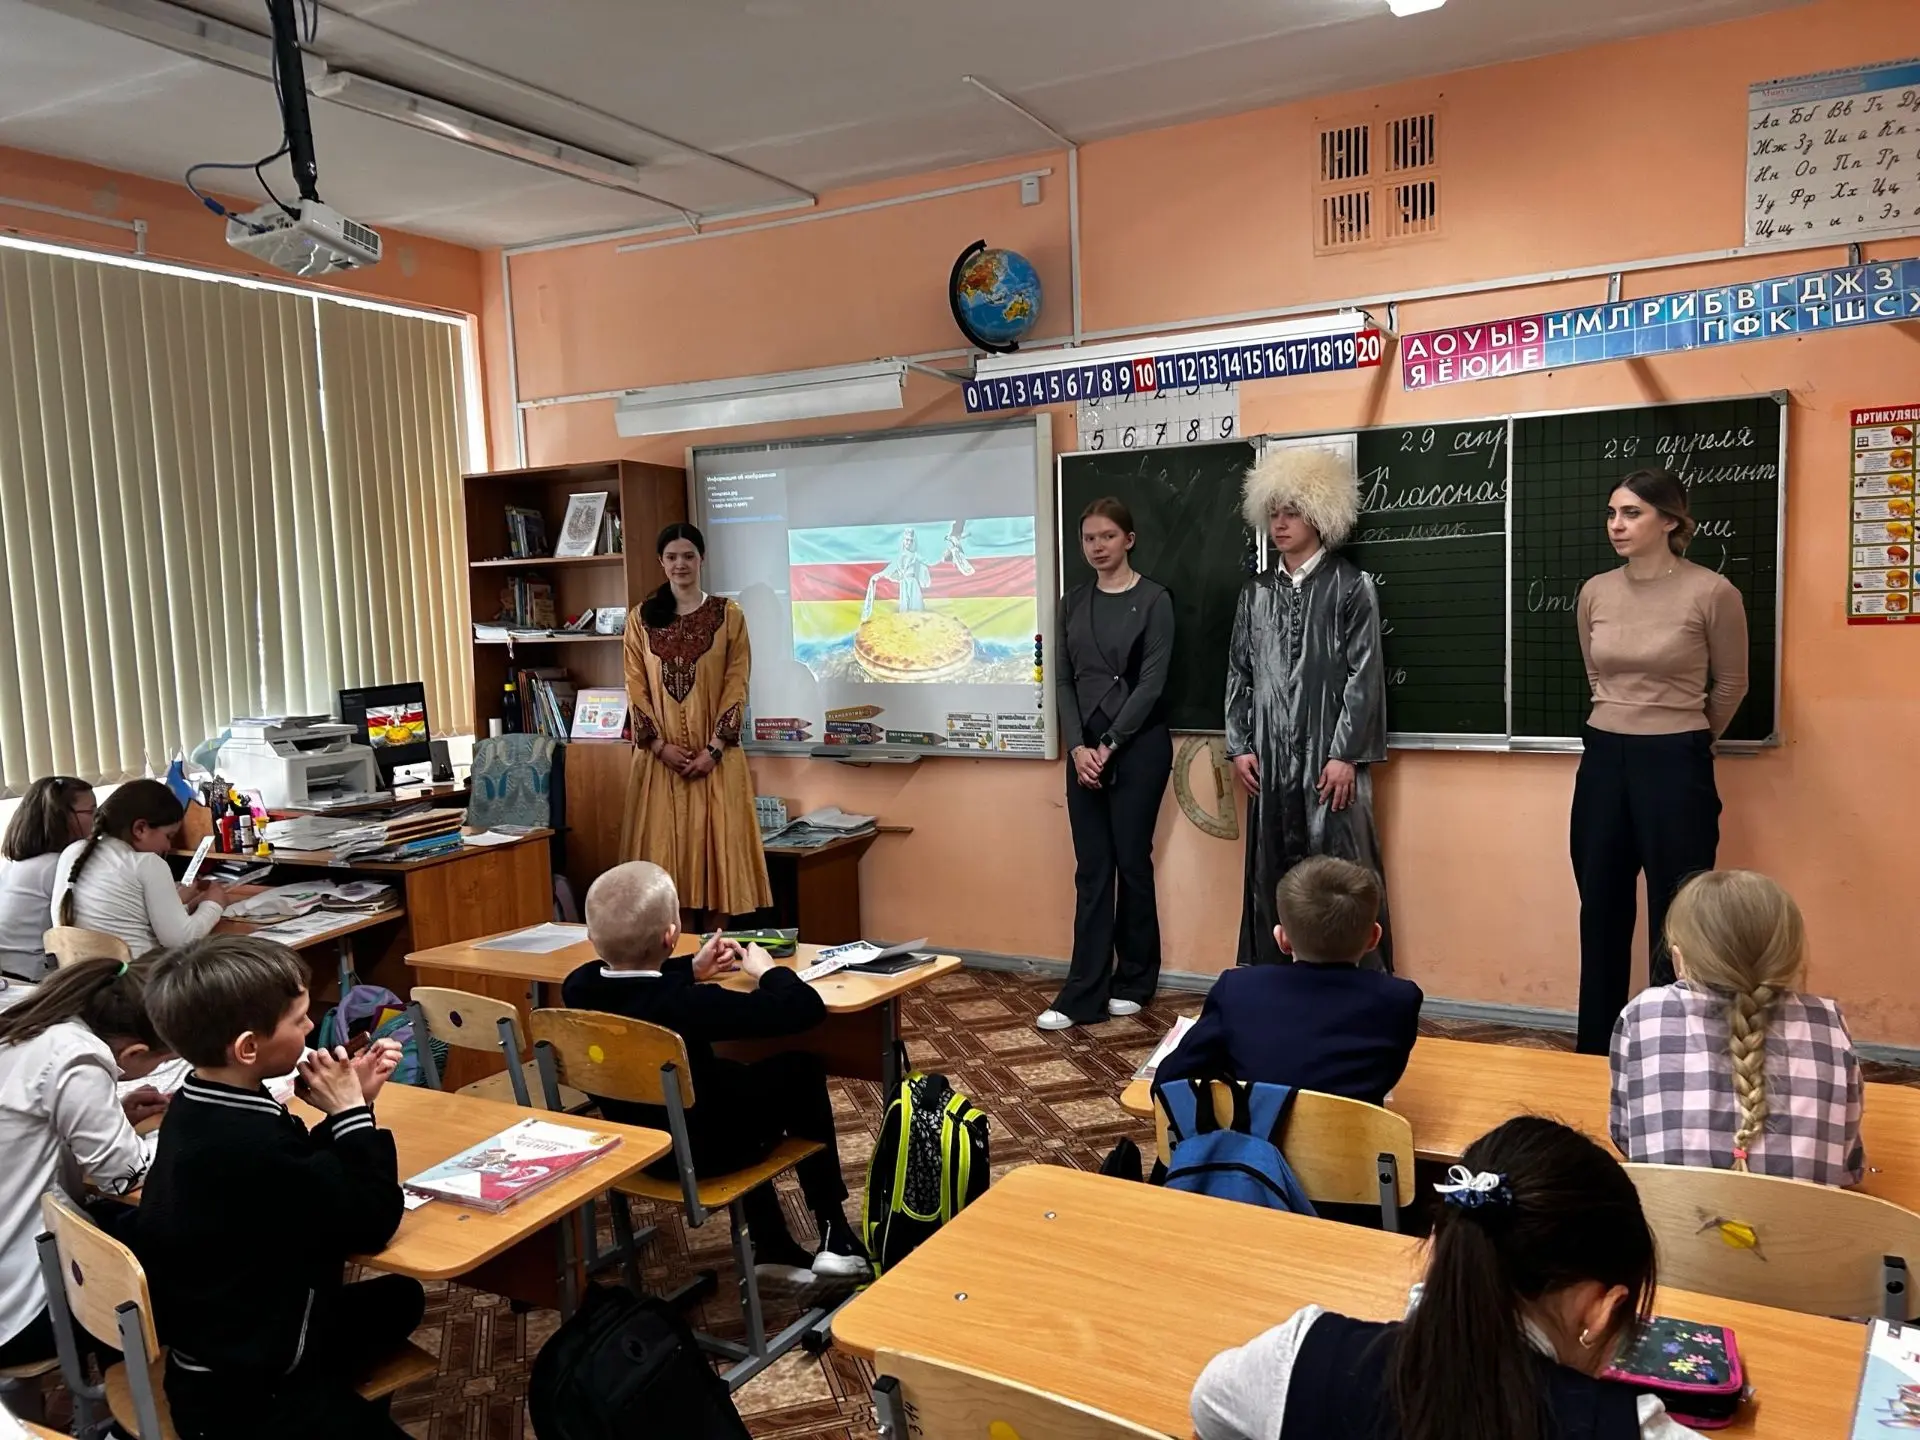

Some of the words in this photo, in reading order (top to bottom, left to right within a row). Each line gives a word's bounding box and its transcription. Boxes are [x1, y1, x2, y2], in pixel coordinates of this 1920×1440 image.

[1753, 113, 1780, 130] Аа
[1789, 105, 1821, 124] Бб
[1827, 100, 1854, 119] Вв
[1863, 95, 1884, 114] Гг
[1753, 139, 1788, 156] Жж
[1794, 133, 1814, 155] Зз
[1824, 128, 1848, 145] Ии
[1754, 165, 1779, 183] Нн
[1795, 160, 1817, 177] Оо
[1833, 153, 1862, 171] Пп
[1755, 193, 1775, 215] Уу
[1789, 188, 1816, 210] Фф
[1830, 181, 1858, 200] Хх
[1872, 177, 1901, 197] Цц
[1755, 219, 1795, 238] Щщ
[1407, 338, 1428, 360] А
[1433, 334, 1457, 355] О
[1462, 329, 1482, 351] У
[1491, 325, 1513, 348] Ы
[1520, 321, 1539, 343] Э
[1548, 317, 1568, 339] Н
[1575, 311, 1602, 335] М
[1608, 306, 1629, 330] Л
[1643, 302, 1661, 324] Р
[1672, 293, 1694, 320] Й
[1705, 293, 1723, 315] Б
[1737, 288, 1756, 310] В
[1772, 282, 1789, 304] Г
[1800, 277, 1827, 303] Д
[1833, 272, 1864, 296] Ж
[1874, 267, 1894, 290] З
[1411, 366, 1425, 387] Я
[1438, 358, 1453, 382] Ё
[1461, 356, 1488, 377] Ю
[1491, 353, 1512, 374] И
[1522, 348, 1538, 369] Е
[1704, 320, 1724, 342] П
[1732, 314, 1761, 336] Ф
[1770, 310, 1791, 332] К
[1805, 306, 1825, 326] Т
[1835, 301, 1865, 323] Ш
[1874, 296, 1896, 316] С
[967, 386, 978, 408] 0
[983, 384, 993, 406] 1
[999, 383, 1011, 404] 2
[1015, 380, 1026, 403] 3
[1033, 378, 1044, 401] 4
[1050, 376, 1060, 398] 5
[1066, 373, 1078, 396] 6
[1084, 371, 1094, 394] 7
[1101, 369, 1113, 392] 8
[1119, 366, 1131, 390] 9
[1135, 363, 1154, 387] 10
[1157, 360, 1174, 385] 11
[1178, 357, 1197, 382] 12
[1200, 355, 1218, 380] 13
[1221, 352, 1241, 377] 14
[1243, 350, 1262, 375] 15
[1265, 347, 1286, 372] 16
[1288, 344, 1308, 370] 17
[1311, 341, 1332, 367] 18
[1334, 338, 1355, 365] 19
[1357, 335, 1379, 362] 20
[1091, 429, 1104, 450] 5
[1122, 426, 1136, 448] 6
[1155, 422, 1167, 445] 7
[1186, 419, 1199, 443] 8
[1219, 415, 1234, 439] 9
[1856, 408, 1920, 424] АРТИКУЛЯЦ
[1400, 427, 1435, 453] 29
[1604, 435, 1641, 459] 29
[1655, 426, 1754, 478] апреля
